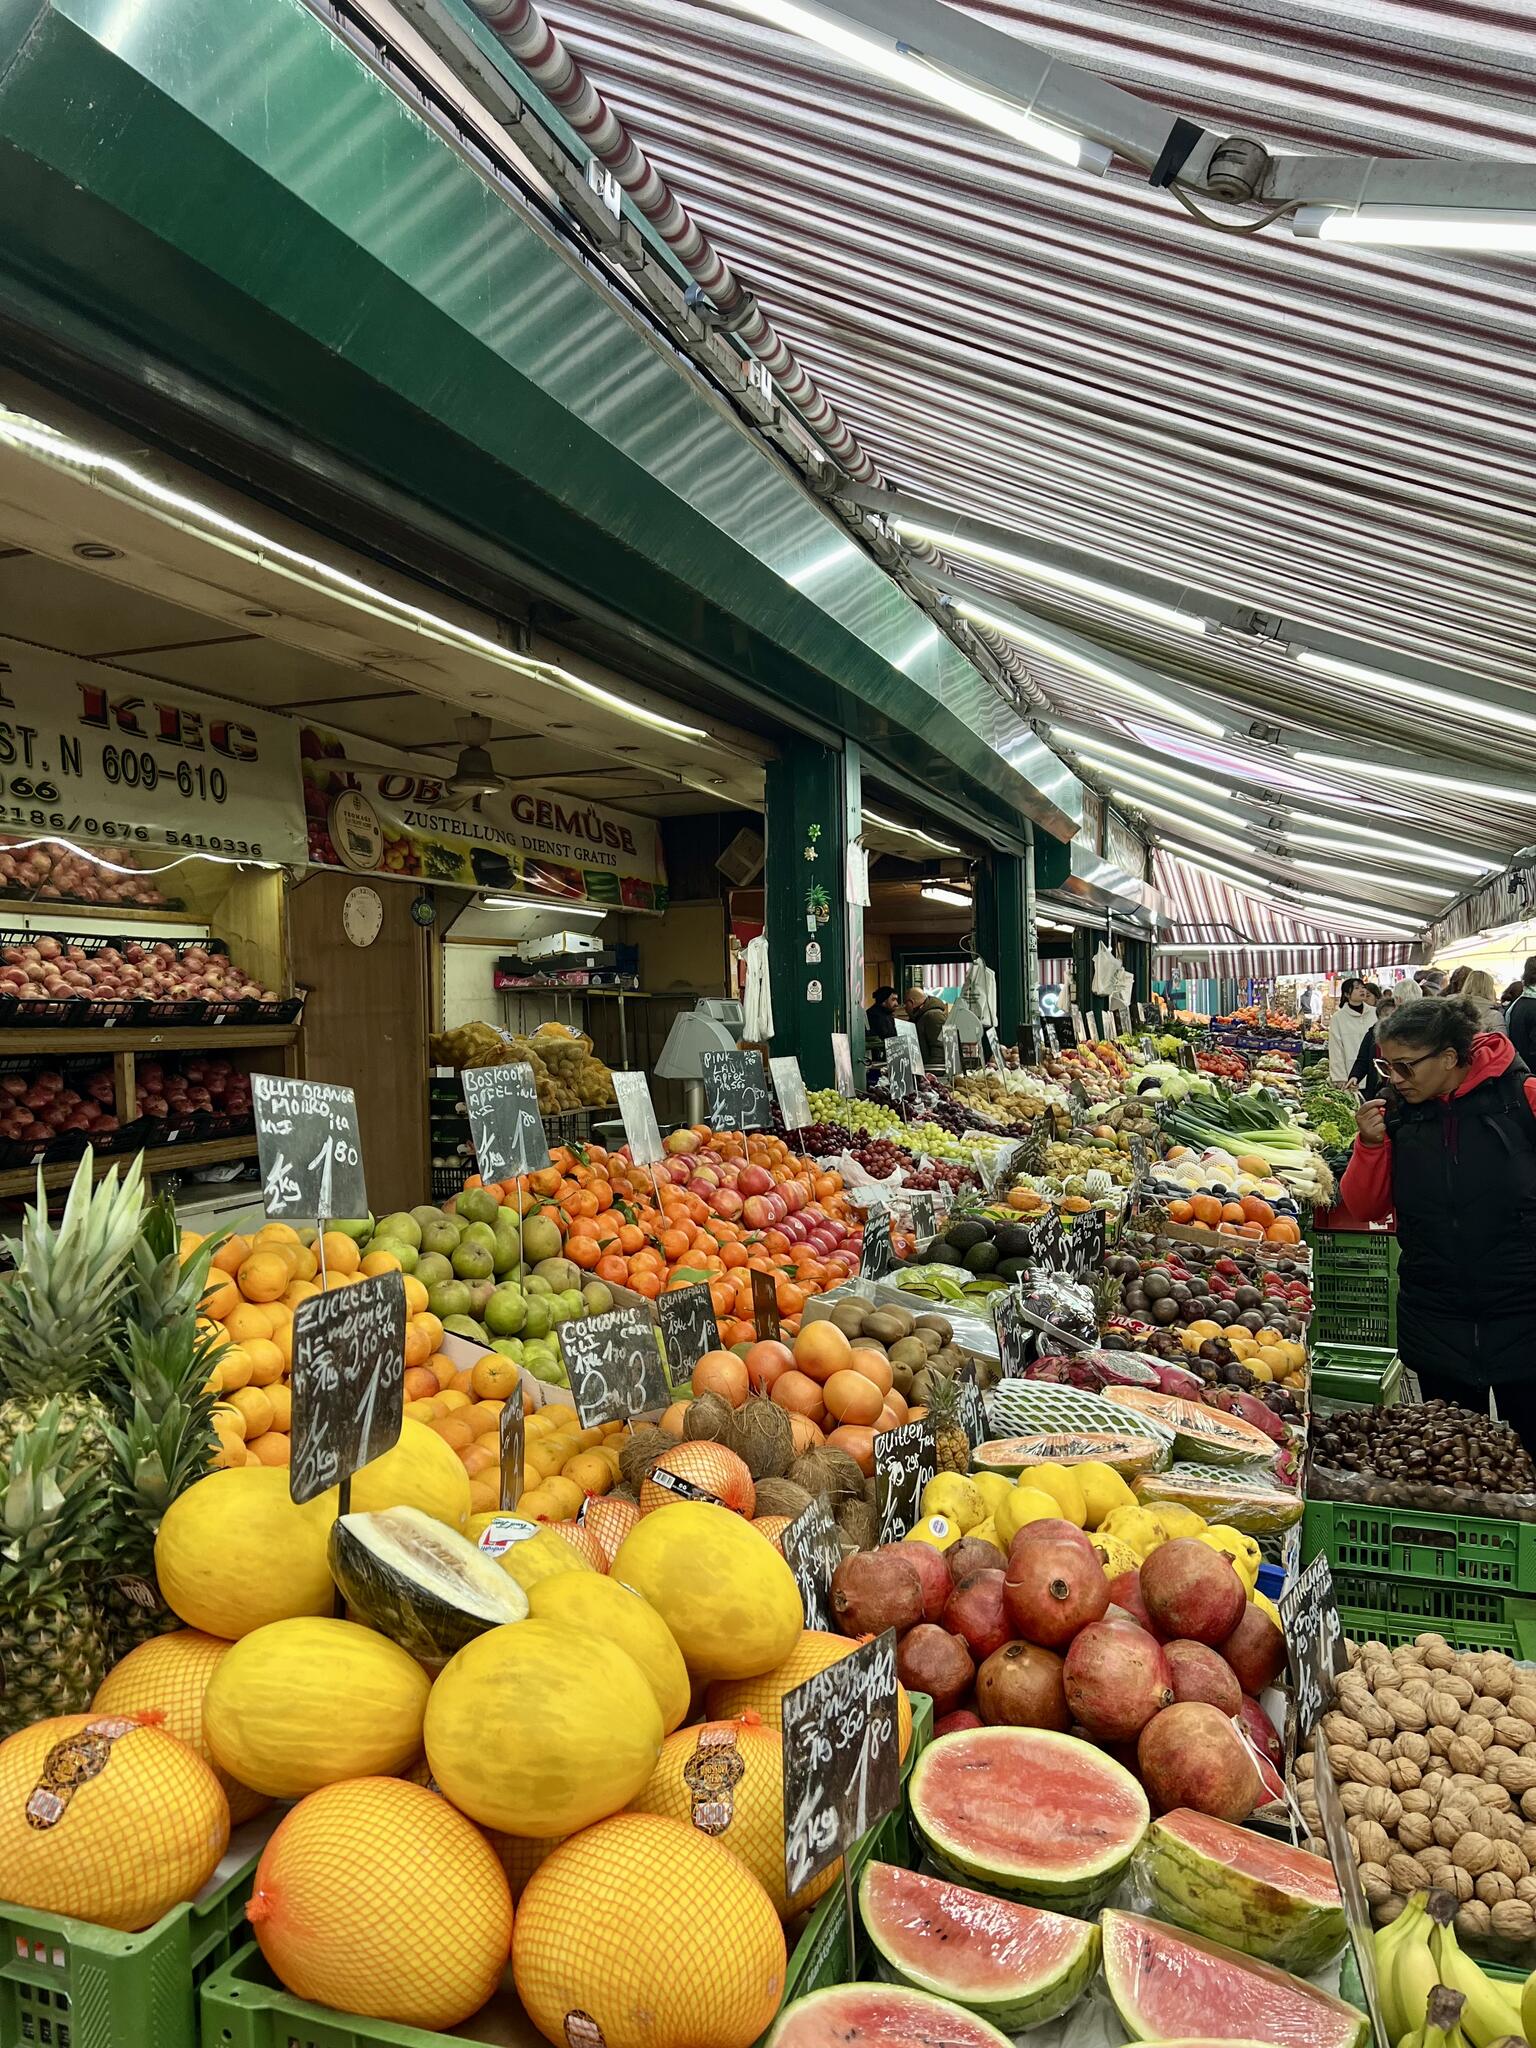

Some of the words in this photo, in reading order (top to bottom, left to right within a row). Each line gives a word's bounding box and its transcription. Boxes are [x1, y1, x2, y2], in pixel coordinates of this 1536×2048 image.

[60, 734, 82, 777] N
[166, 830, 263, 856] 5410336
[403, 809, 517, 847] ZUSTELLUNG
[522, 835, 572, 860] DIENST
[573, 847, 618, 867] GRATIS
[511, 794, 638, 857] GEMÜSE
